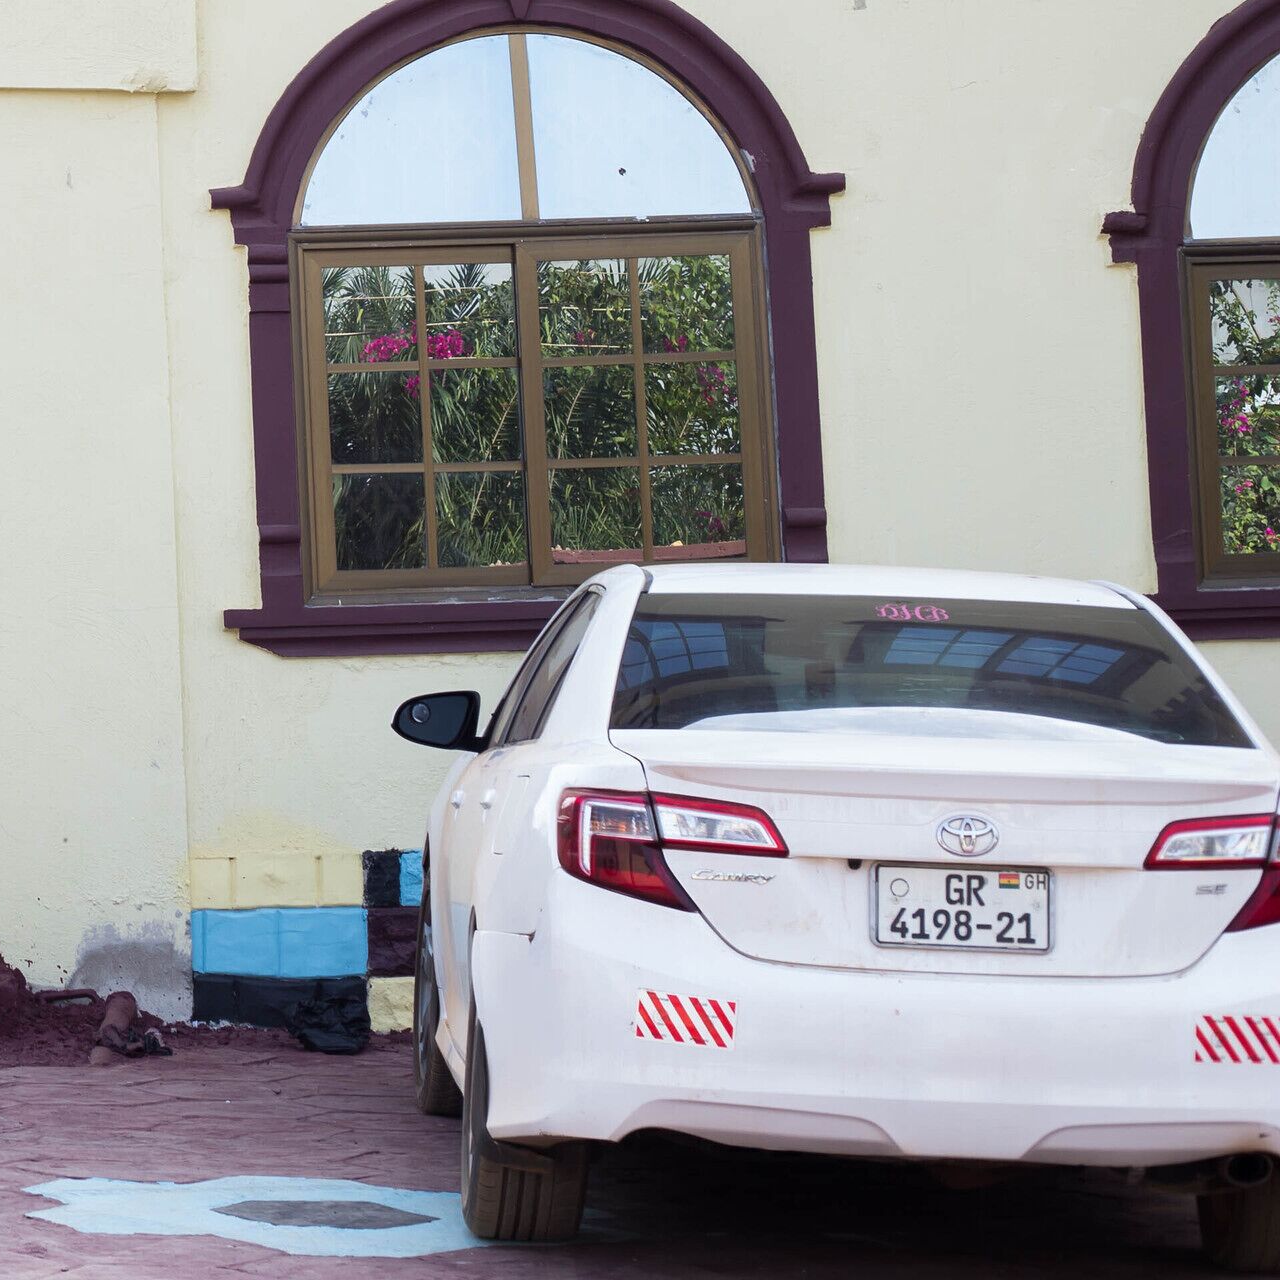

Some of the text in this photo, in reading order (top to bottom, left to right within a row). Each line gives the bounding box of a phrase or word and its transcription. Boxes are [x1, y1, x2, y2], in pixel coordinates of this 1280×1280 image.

[945, 873, 986, 907] GR
[1024, 874, 1047, 891] GH
[890, 907, 1037, 945] 4198-21
